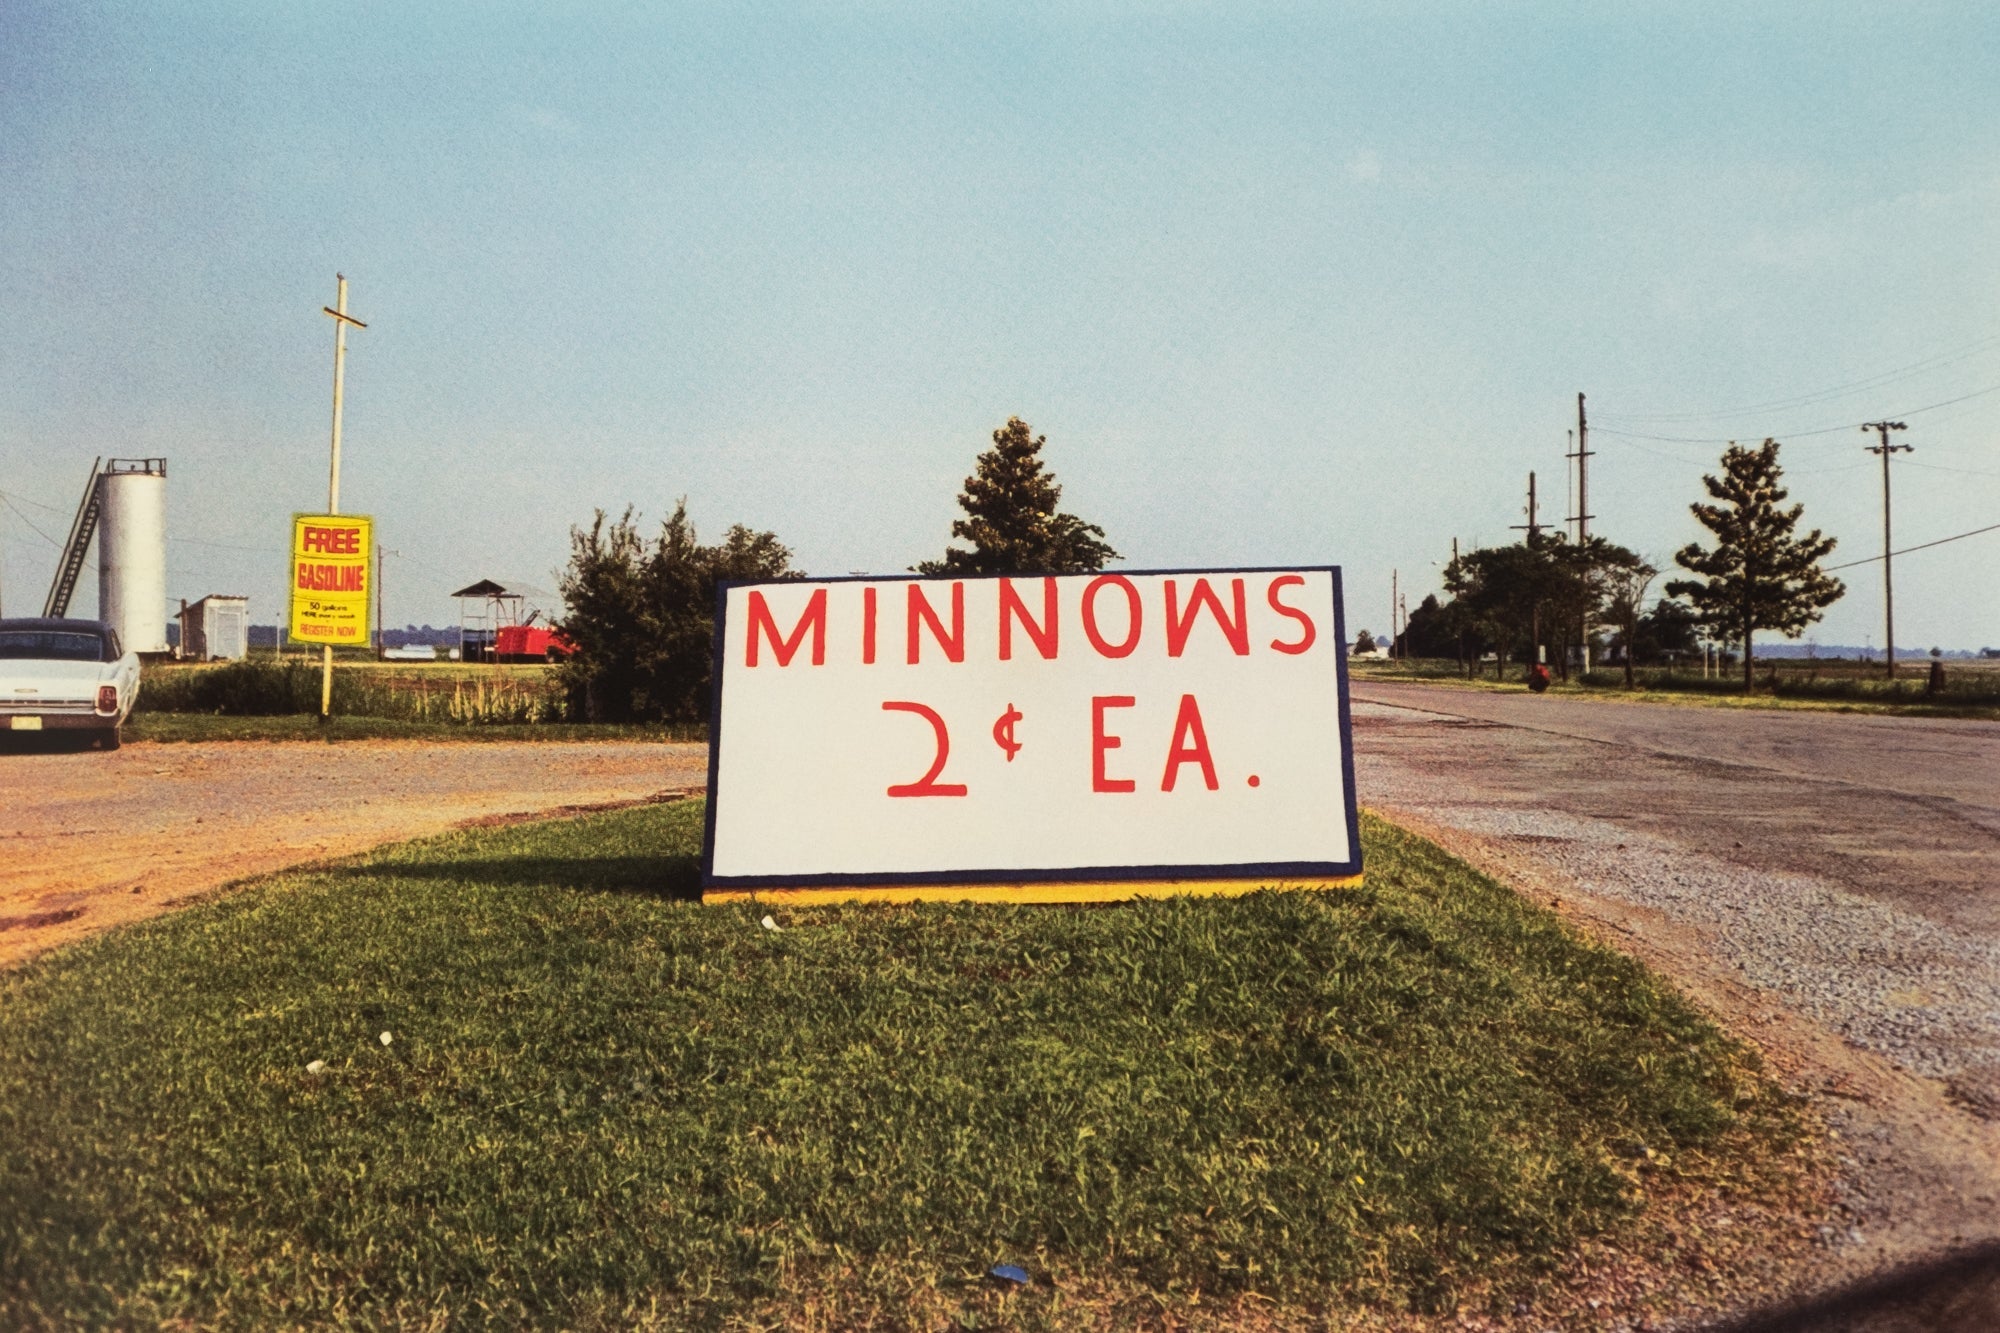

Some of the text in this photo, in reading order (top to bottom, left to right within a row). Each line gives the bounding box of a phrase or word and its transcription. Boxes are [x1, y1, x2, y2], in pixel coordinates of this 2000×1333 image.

[303, 526, 360, 554] FREE
[298, 563, 364, 592] GASOLINE
[310, 601, 320, 610] 50
[300, 623, 357, 637] REGISTER NOW
[745, 574, 1316, 668] MINNOWS
[1091, 694, 1260, 793] EA.
